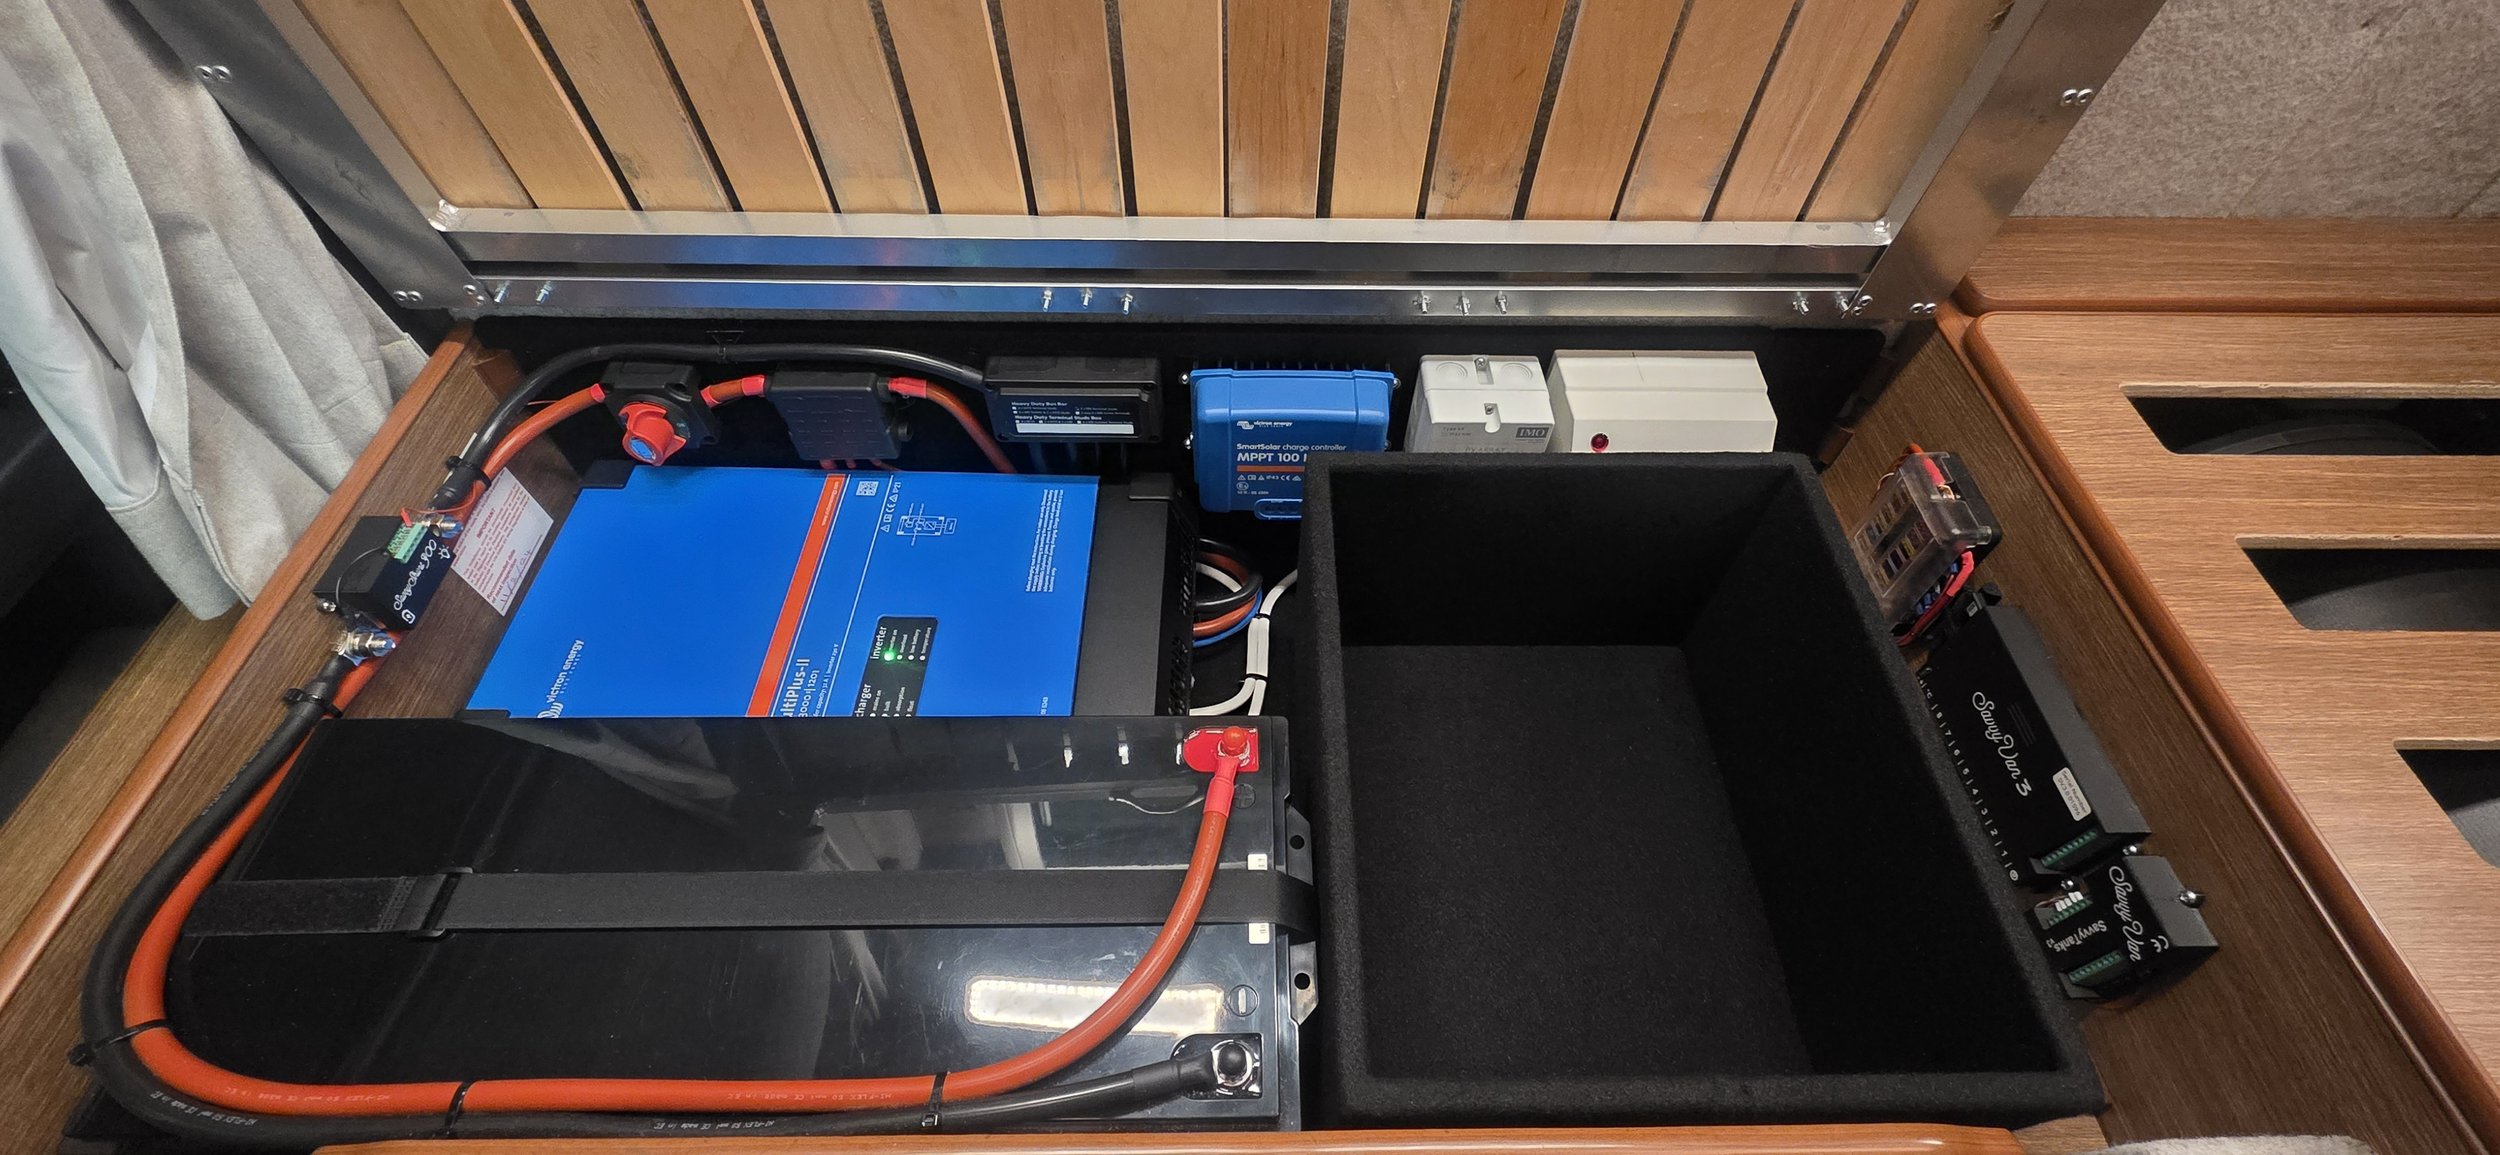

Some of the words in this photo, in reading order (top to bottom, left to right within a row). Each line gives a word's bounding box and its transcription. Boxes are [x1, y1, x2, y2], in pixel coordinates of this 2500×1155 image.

[1519, 429, 1545, 437] IMO
[1237, 453, 1274, 461] MPPT
[1278, 453, 1299, 462] 100
[1311, 443, 1346, 451] controller
[475, 506, 495, 538] IMPORTANT
[870, 625, 887, 659] Inverter
[546, 670, 567, 703] victron
[562, 639, 584, 670] energy
[2015, 778, 2032, 795] 3
[2053, 919, 2107, 952] SavvyTanks
